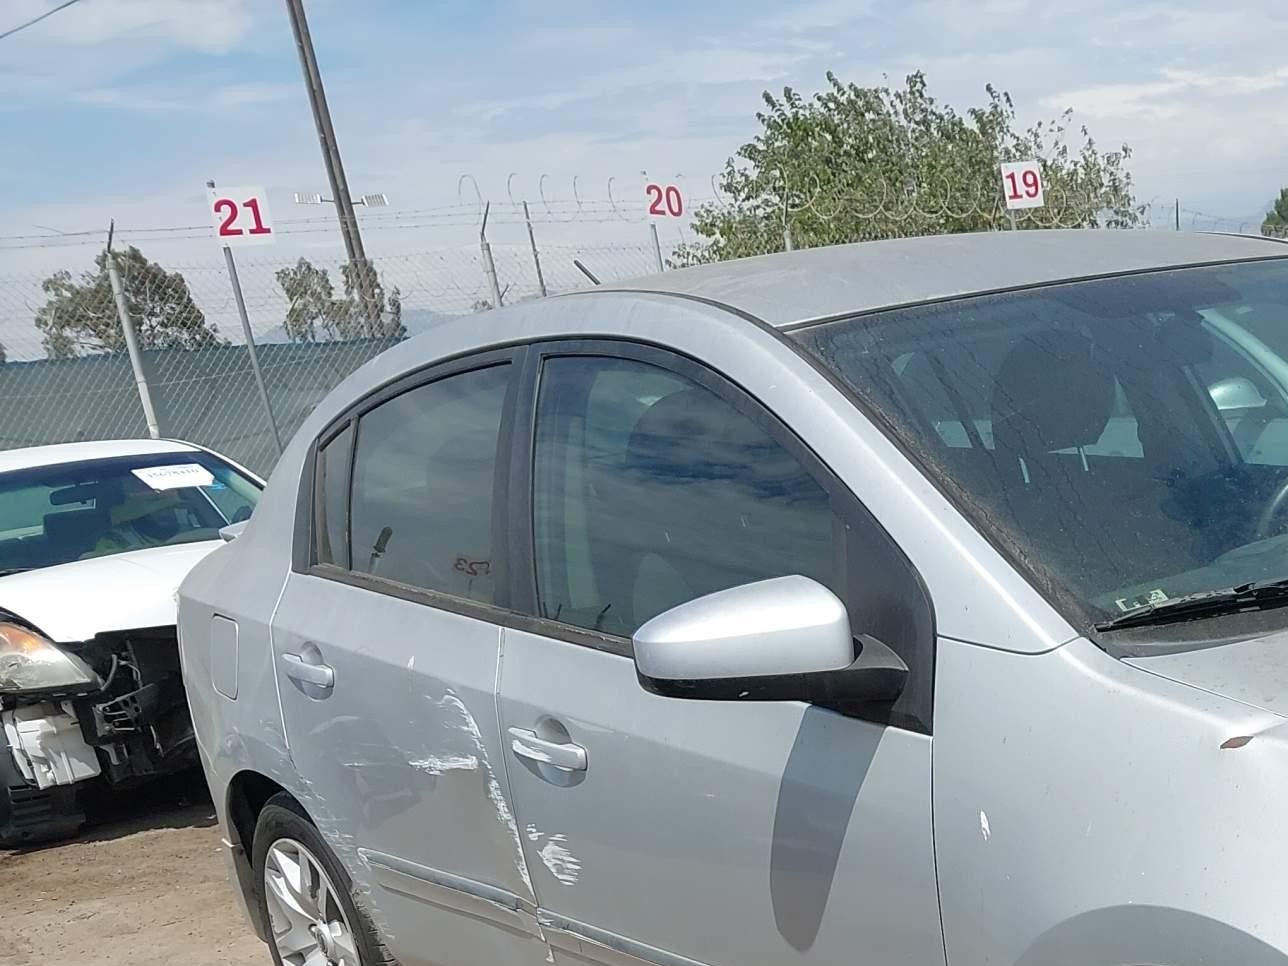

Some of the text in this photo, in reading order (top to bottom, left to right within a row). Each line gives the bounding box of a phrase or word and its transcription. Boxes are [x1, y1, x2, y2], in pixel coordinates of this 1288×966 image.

[1005, 170, 1039, 199] 19
[214, 198, 271, 236] 21
[646, 185, 682, 217] 20
